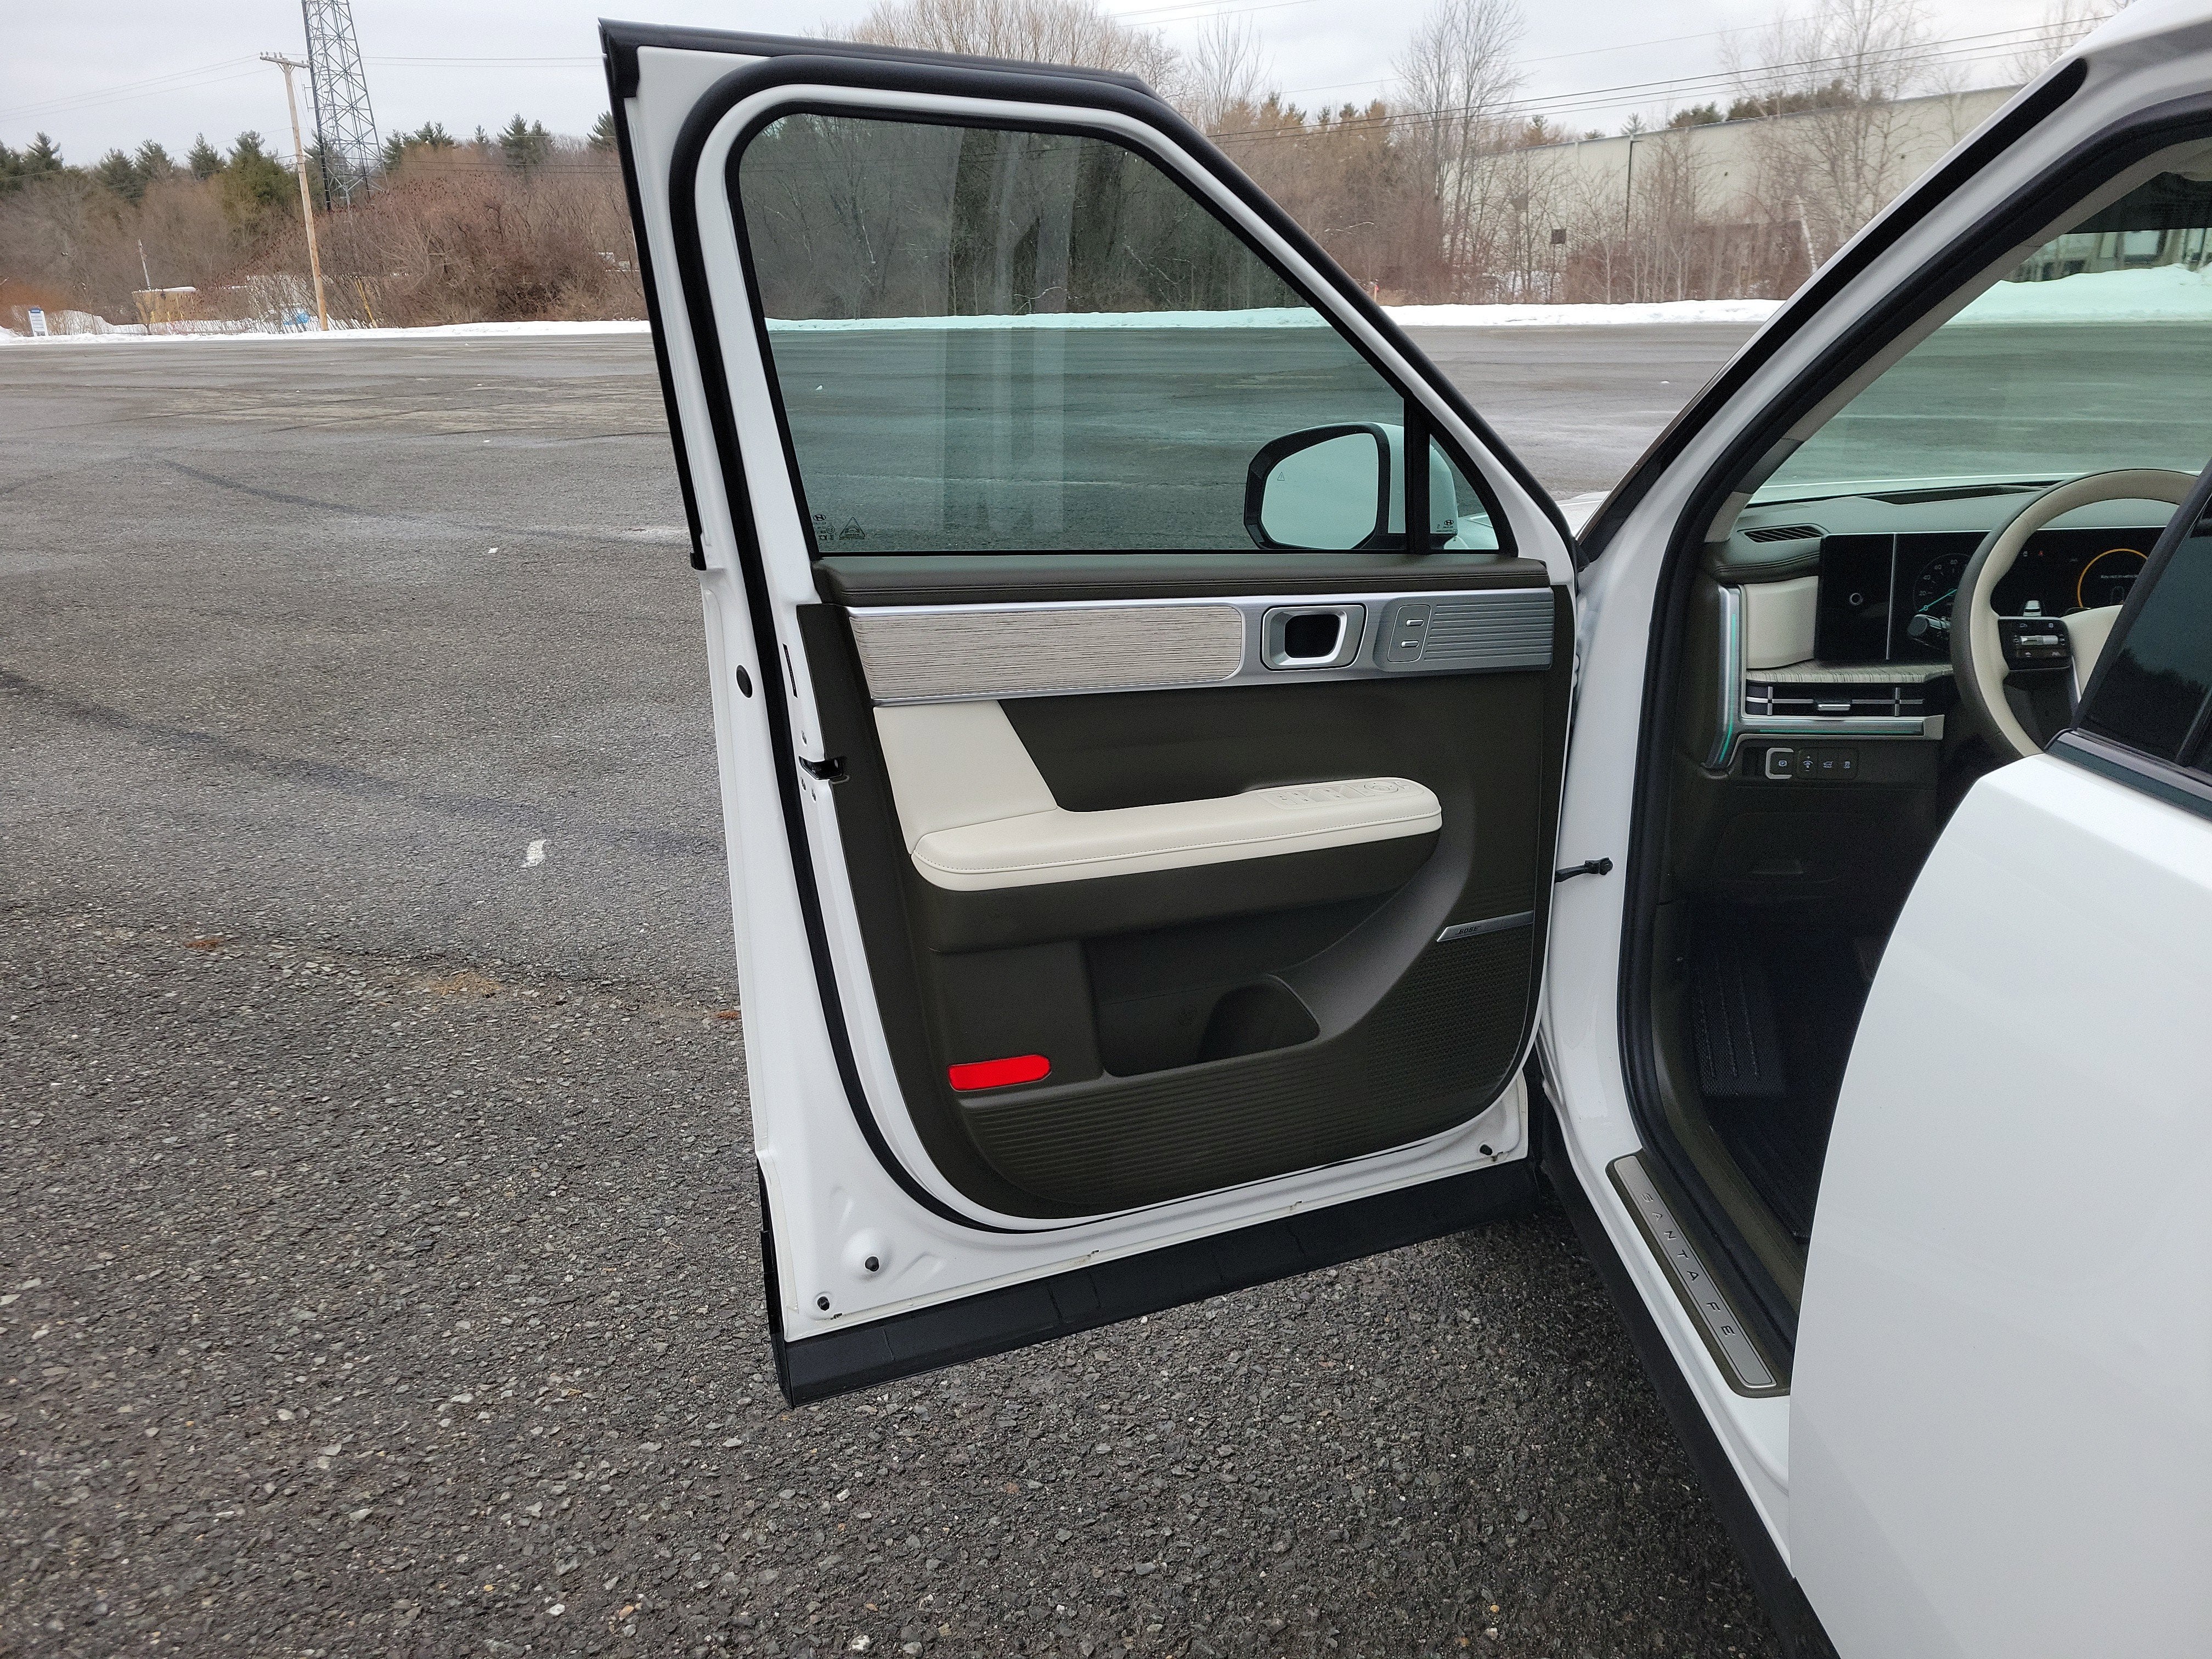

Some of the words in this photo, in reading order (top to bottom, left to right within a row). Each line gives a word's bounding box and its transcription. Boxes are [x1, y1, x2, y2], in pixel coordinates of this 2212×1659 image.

[1455, 926, 1481, 935] BOSE
[1641, 1192, 1699, 1282] SANTA
[1706, 1301, 1736, 1337] FE
